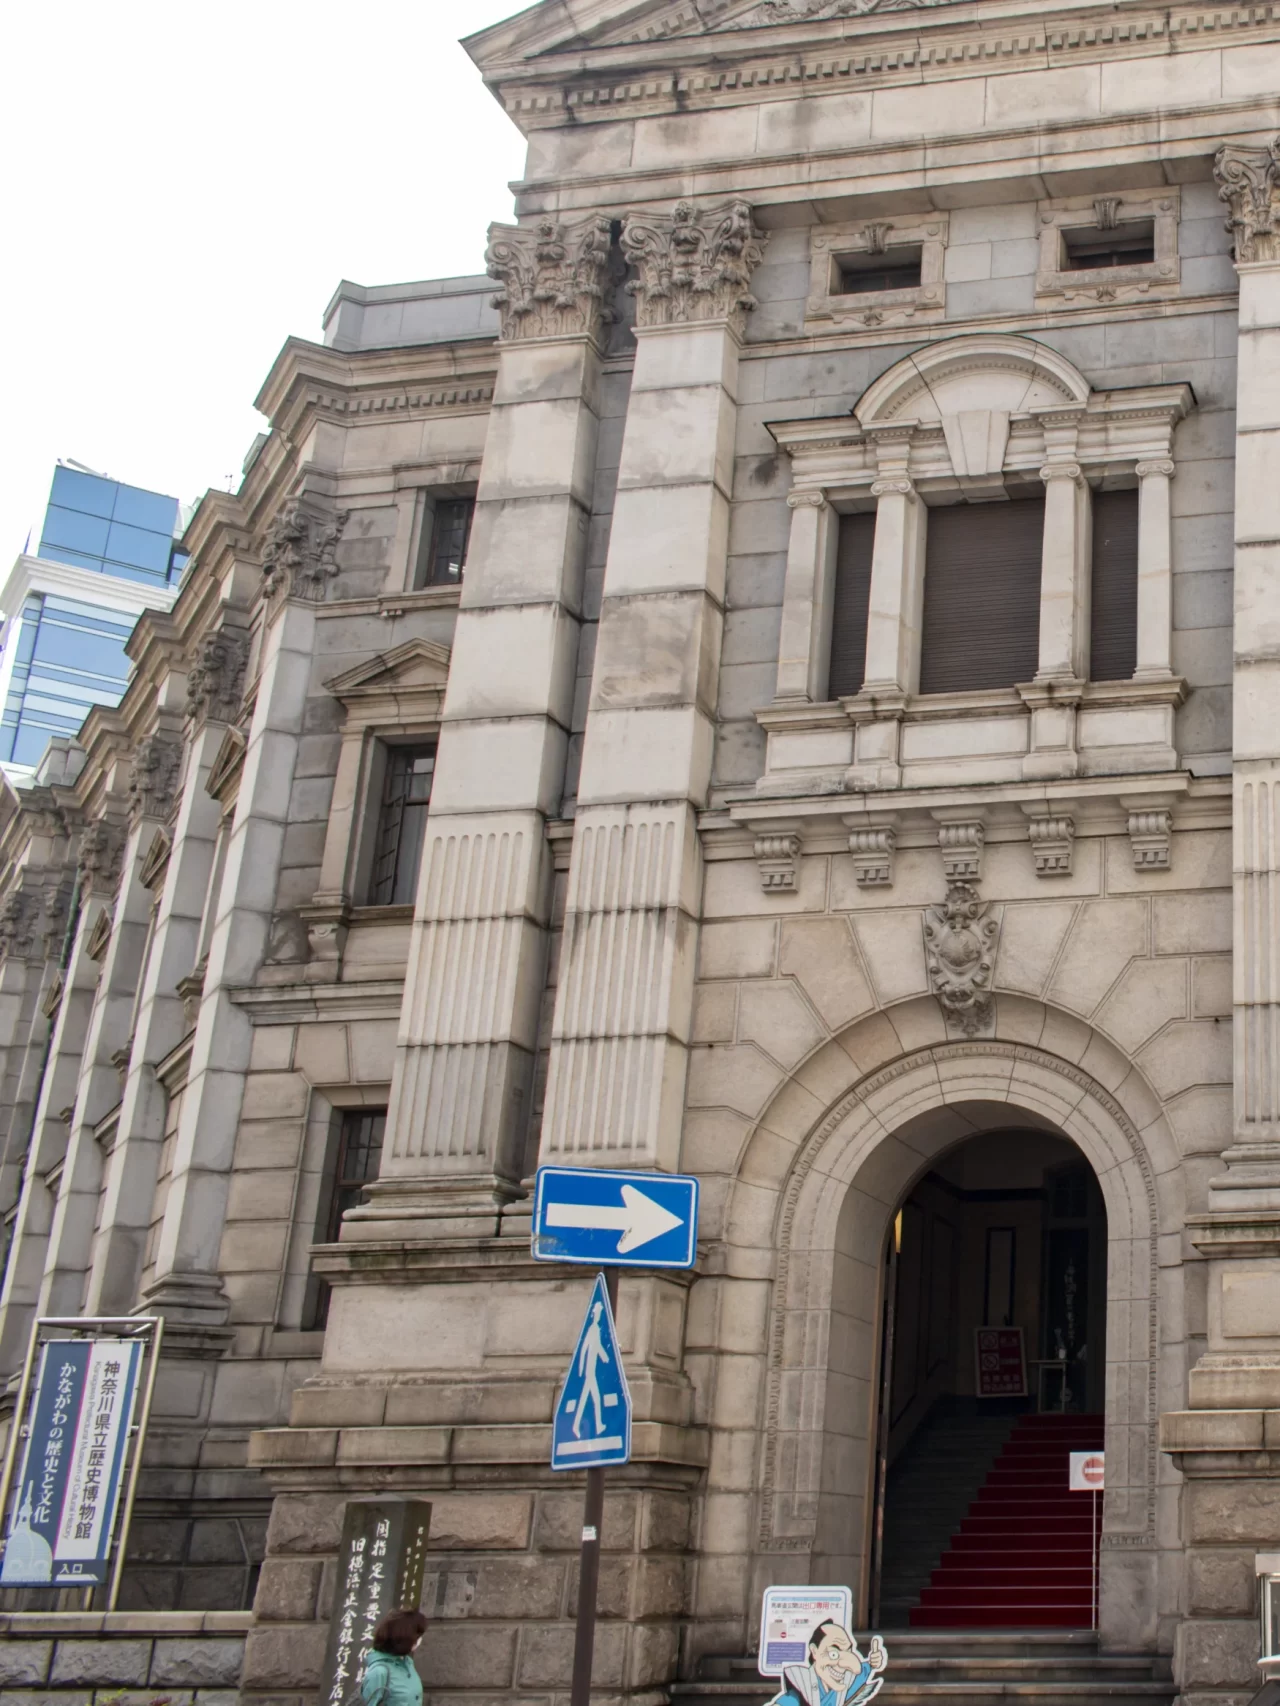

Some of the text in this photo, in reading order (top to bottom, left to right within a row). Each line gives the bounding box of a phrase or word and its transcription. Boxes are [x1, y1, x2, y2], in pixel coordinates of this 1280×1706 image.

[33, 1361, 77, 1524] かながわの歴史と文化
[75, 1361, 121, 1540] 神奈川県立歴史博物館
[60, 1563, 83, 1574] 入口
